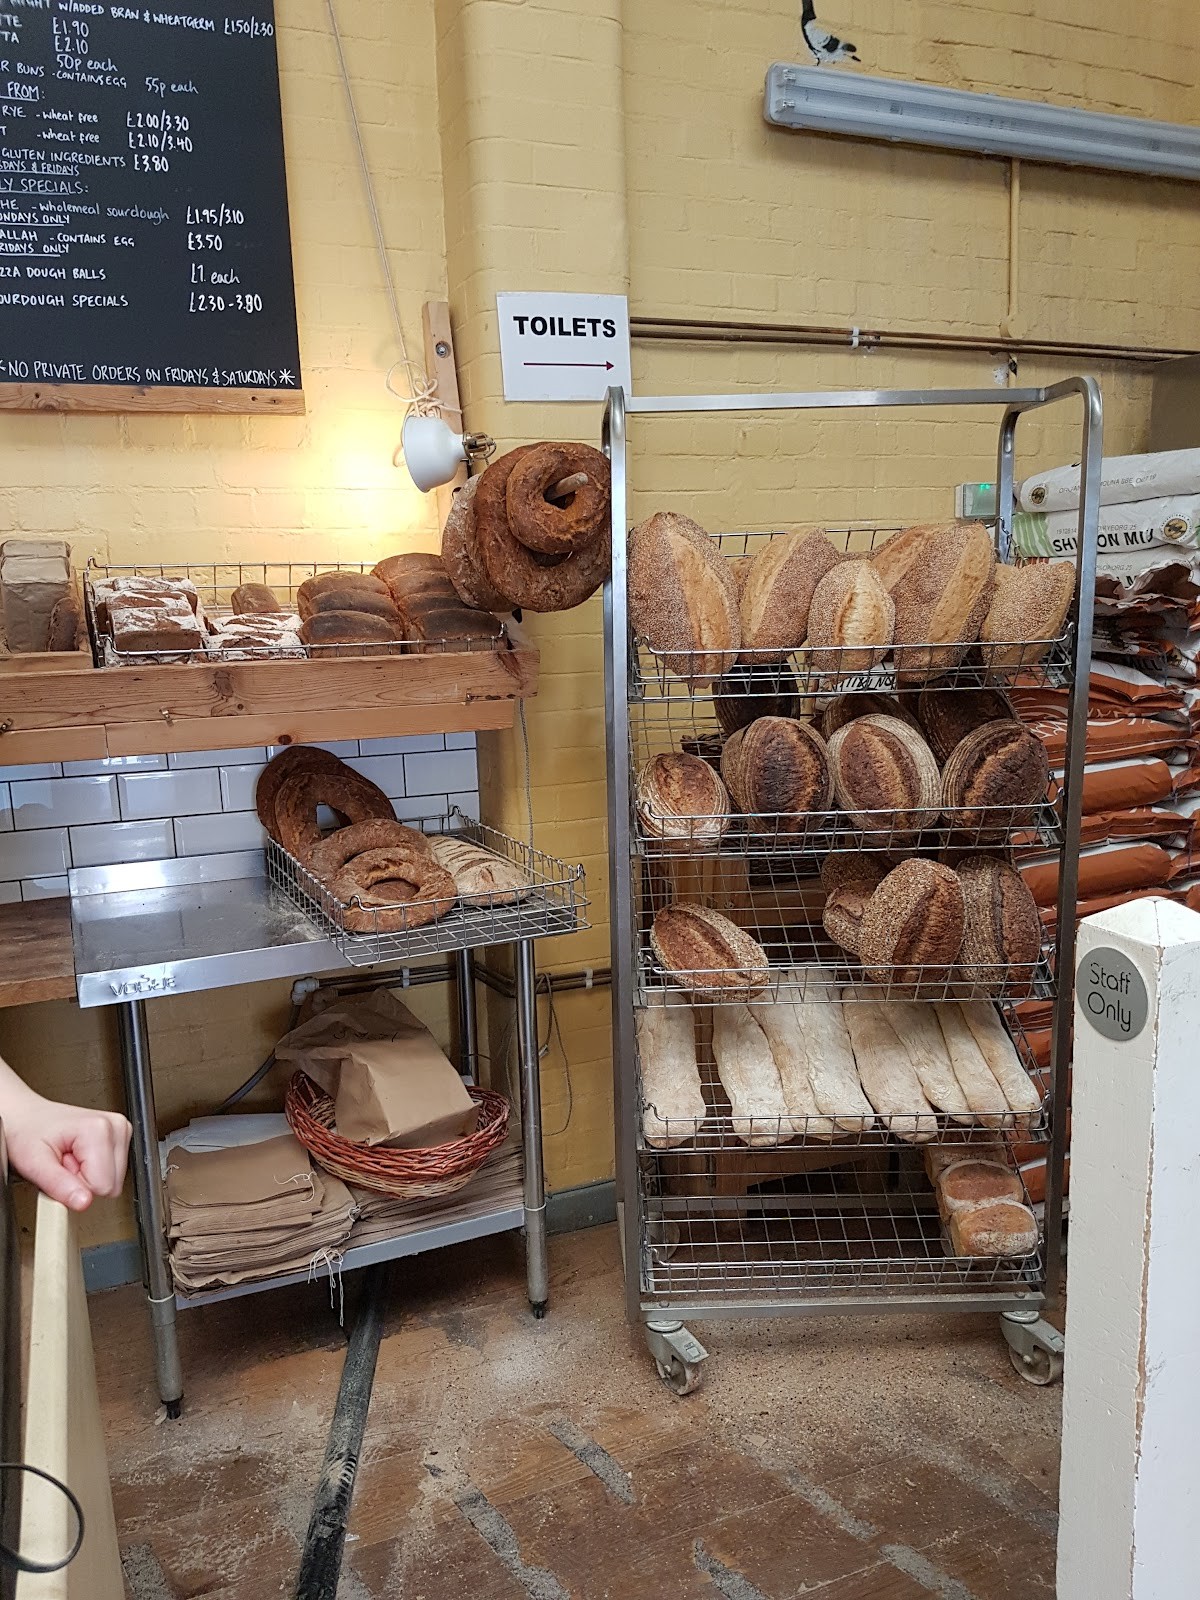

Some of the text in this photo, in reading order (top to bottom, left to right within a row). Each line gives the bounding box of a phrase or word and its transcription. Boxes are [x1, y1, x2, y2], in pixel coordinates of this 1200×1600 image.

[52, 16, 89, 38] £1.90
[110, 6, 140, 20] BRAN
[152, 13, 215, 32] WHEATGERM
[54, 35, 89, 55] £2.10
[86, 58, 119, 72] each
[16, 62, 45, 78] BUNS
[170, 80, 199, 95] each
[2, 105, 27, 118] RYE
[78, 111, 99, 124] free
[79, 131, 101, 145] free
[1, 147, 170, 173] GLUTEN INGREDIENTS £3.80
[41, 162, 80, 177] FRIDAYS
[42, 214, 70, 224] ONLY
[106, 204, 170, 226] sourdough
[42, 244, 70, 254] ONLY
[113, 236, 135, 247] EGG
[188, 231, 223, 251] £3.50
[26, 267, 67, 280] DOUGH
[72, 267, 107, 281] BALLS
[210, 268, 241, 285] each
[72, 294, 129, 308] SPECIALS
[512, 315, 617, 338] TOILETS
[33, 360, 87, 381] PRIVATE
[91, 363, 141, 383] ORDERS
[145, 367, 161, 382] ON
[164, 366, 209, 385] FRIDAYS
[211, 367, 220, 386] &
[1089, 962, 1132, 995] Staff
[1087, 991, 1131, 1033] Only
